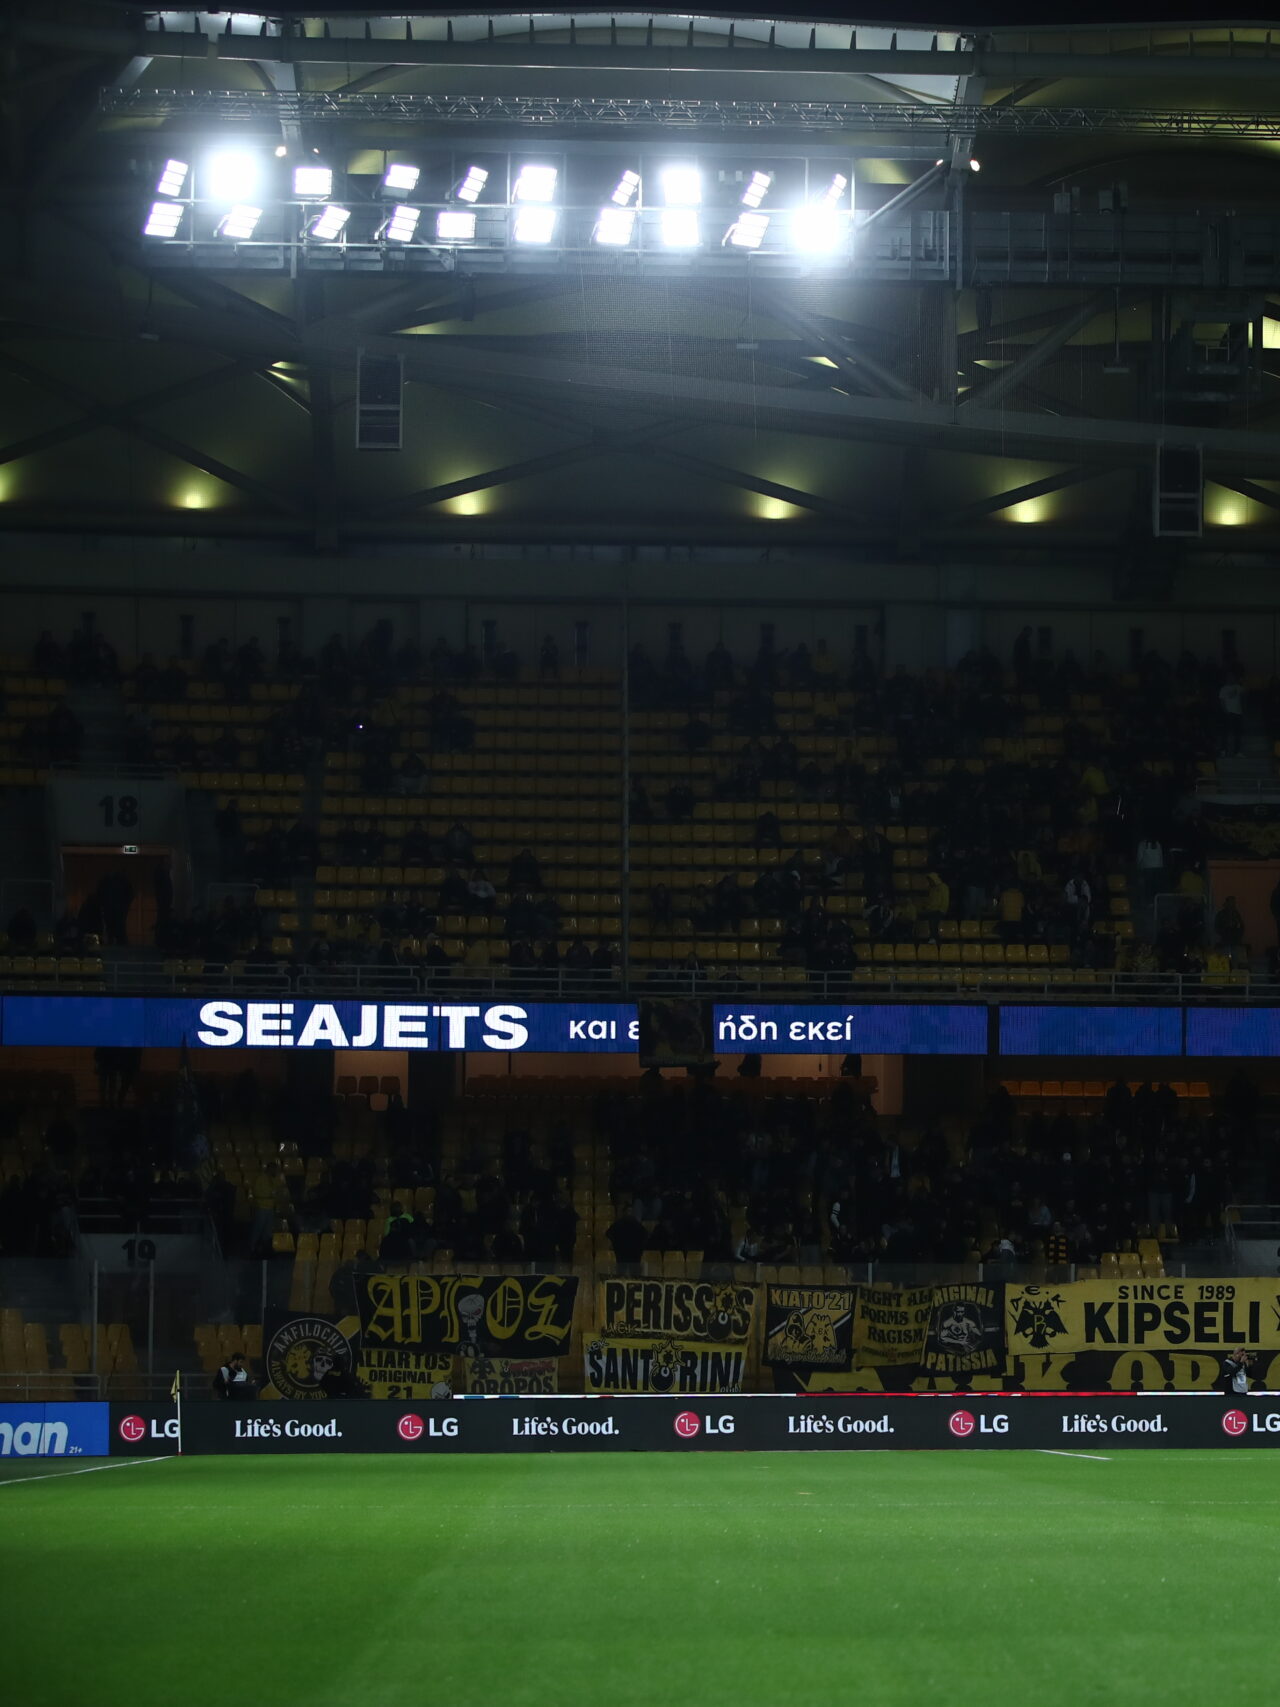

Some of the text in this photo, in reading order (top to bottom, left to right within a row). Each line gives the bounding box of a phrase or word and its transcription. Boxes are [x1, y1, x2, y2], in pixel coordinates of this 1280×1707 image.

[98, 795, 139, 828] 18
[197, 1001, 529, 1050] SEAJETS
[568, 1020, 617, 1040] και
[719, 1014, 778, 1041] ήδη
[789, 1014, 854, 1041] εκεί
[121, 1238, 156, 1261] 19
[1117, 1285, 1236, 1301] SINCE 1989
[861, 1305, 909, 1326] FORMS
[1084, 1301, 1260, 1345] KIPSELI
[868, 1326, 925, 1345] RACISM
[926, 1348, 998, 1372] PATISSIA
[369, 1369, 434, 1385] ORIGINAL
[387, 1385, 413, 1400] 21
[151, 1419, 180, 1438] LG
[285, 1419, 343, 1438] Good.
[430, 1417, 459, 1437] LG
[562, 1417, 620, 1436] Good.
[706, 1415, 735, 1434] LG
[838, 1414, 895, 1433] Good.
[980, 1414, 1009, 1434] LG
[1111, 1414, 1168, 1433] Good.
